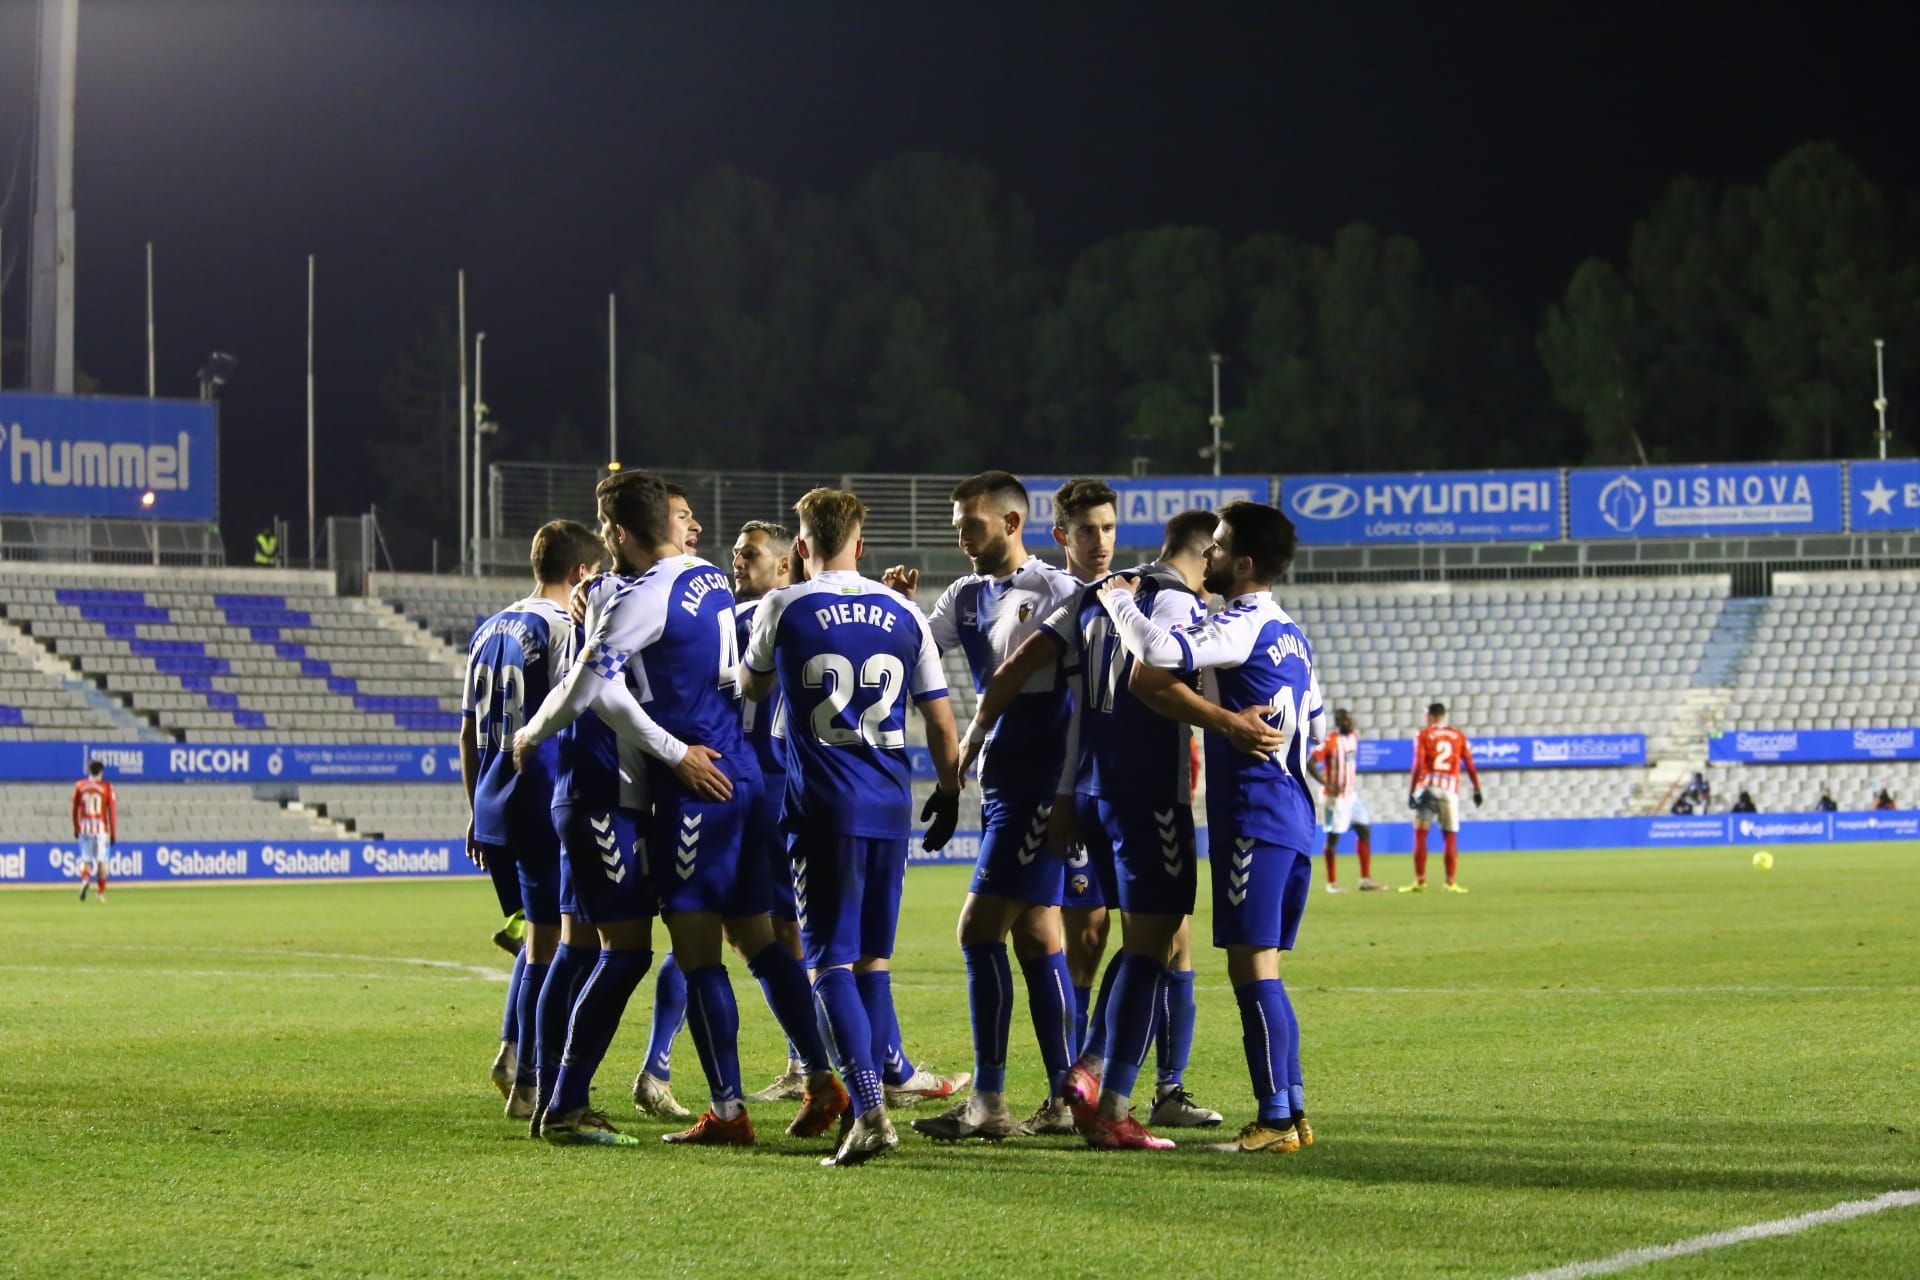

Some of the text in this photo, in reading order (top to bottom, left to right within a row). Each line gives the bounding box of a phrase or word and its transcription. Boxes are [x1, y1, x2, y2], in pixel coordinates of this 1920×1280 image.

[11, 423, 189, 490] hummel
[1365, 480, 1550, 516] HYUNDAI
[1653, 474, 1812, 506] DISNOVA
[680, 575, 712, 617] ALEIX
[815, 603, 897, 633] PIERRE
[717, 606, 742, 699] 4
[473, 663, 525, 752] 23
[802, 653, 905, 749] 22
[170, 749, 249, 773] RICOH
[1433, 741, 1453, 770] 2
[82, 793, 102, 815] 10
[169, 849, 247, 875] Sabadell
[273, 848, 350, 874] Sabadell
[375, 846, 449, 872] Sabadell
